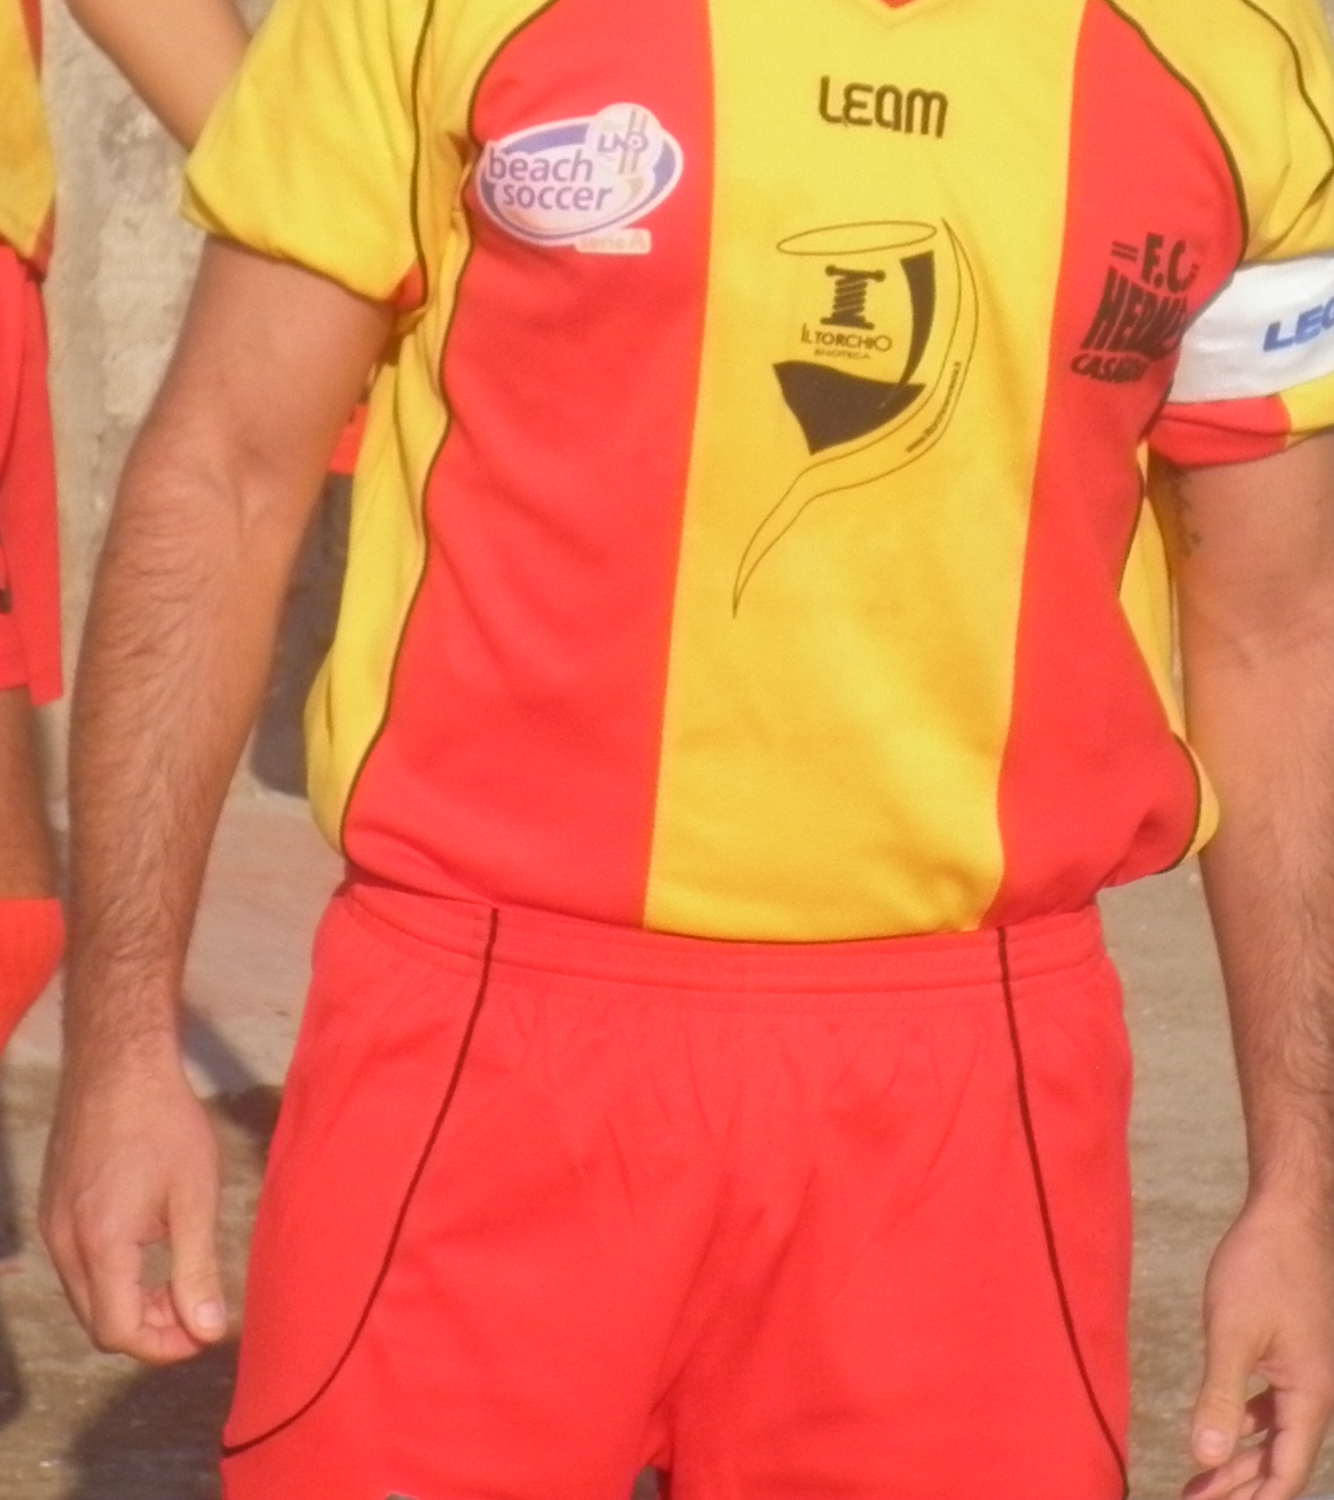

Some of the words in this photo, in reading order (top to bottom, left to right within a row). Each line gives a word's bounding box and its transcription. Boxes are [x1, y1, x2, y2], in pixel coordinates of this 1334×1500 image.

[818, 74, 949, 140] LEAM
[487, 146, 594, 184] beach
[502, 182, 613, 211] soccer
[814, 331, 893, 353] TORCHIO
